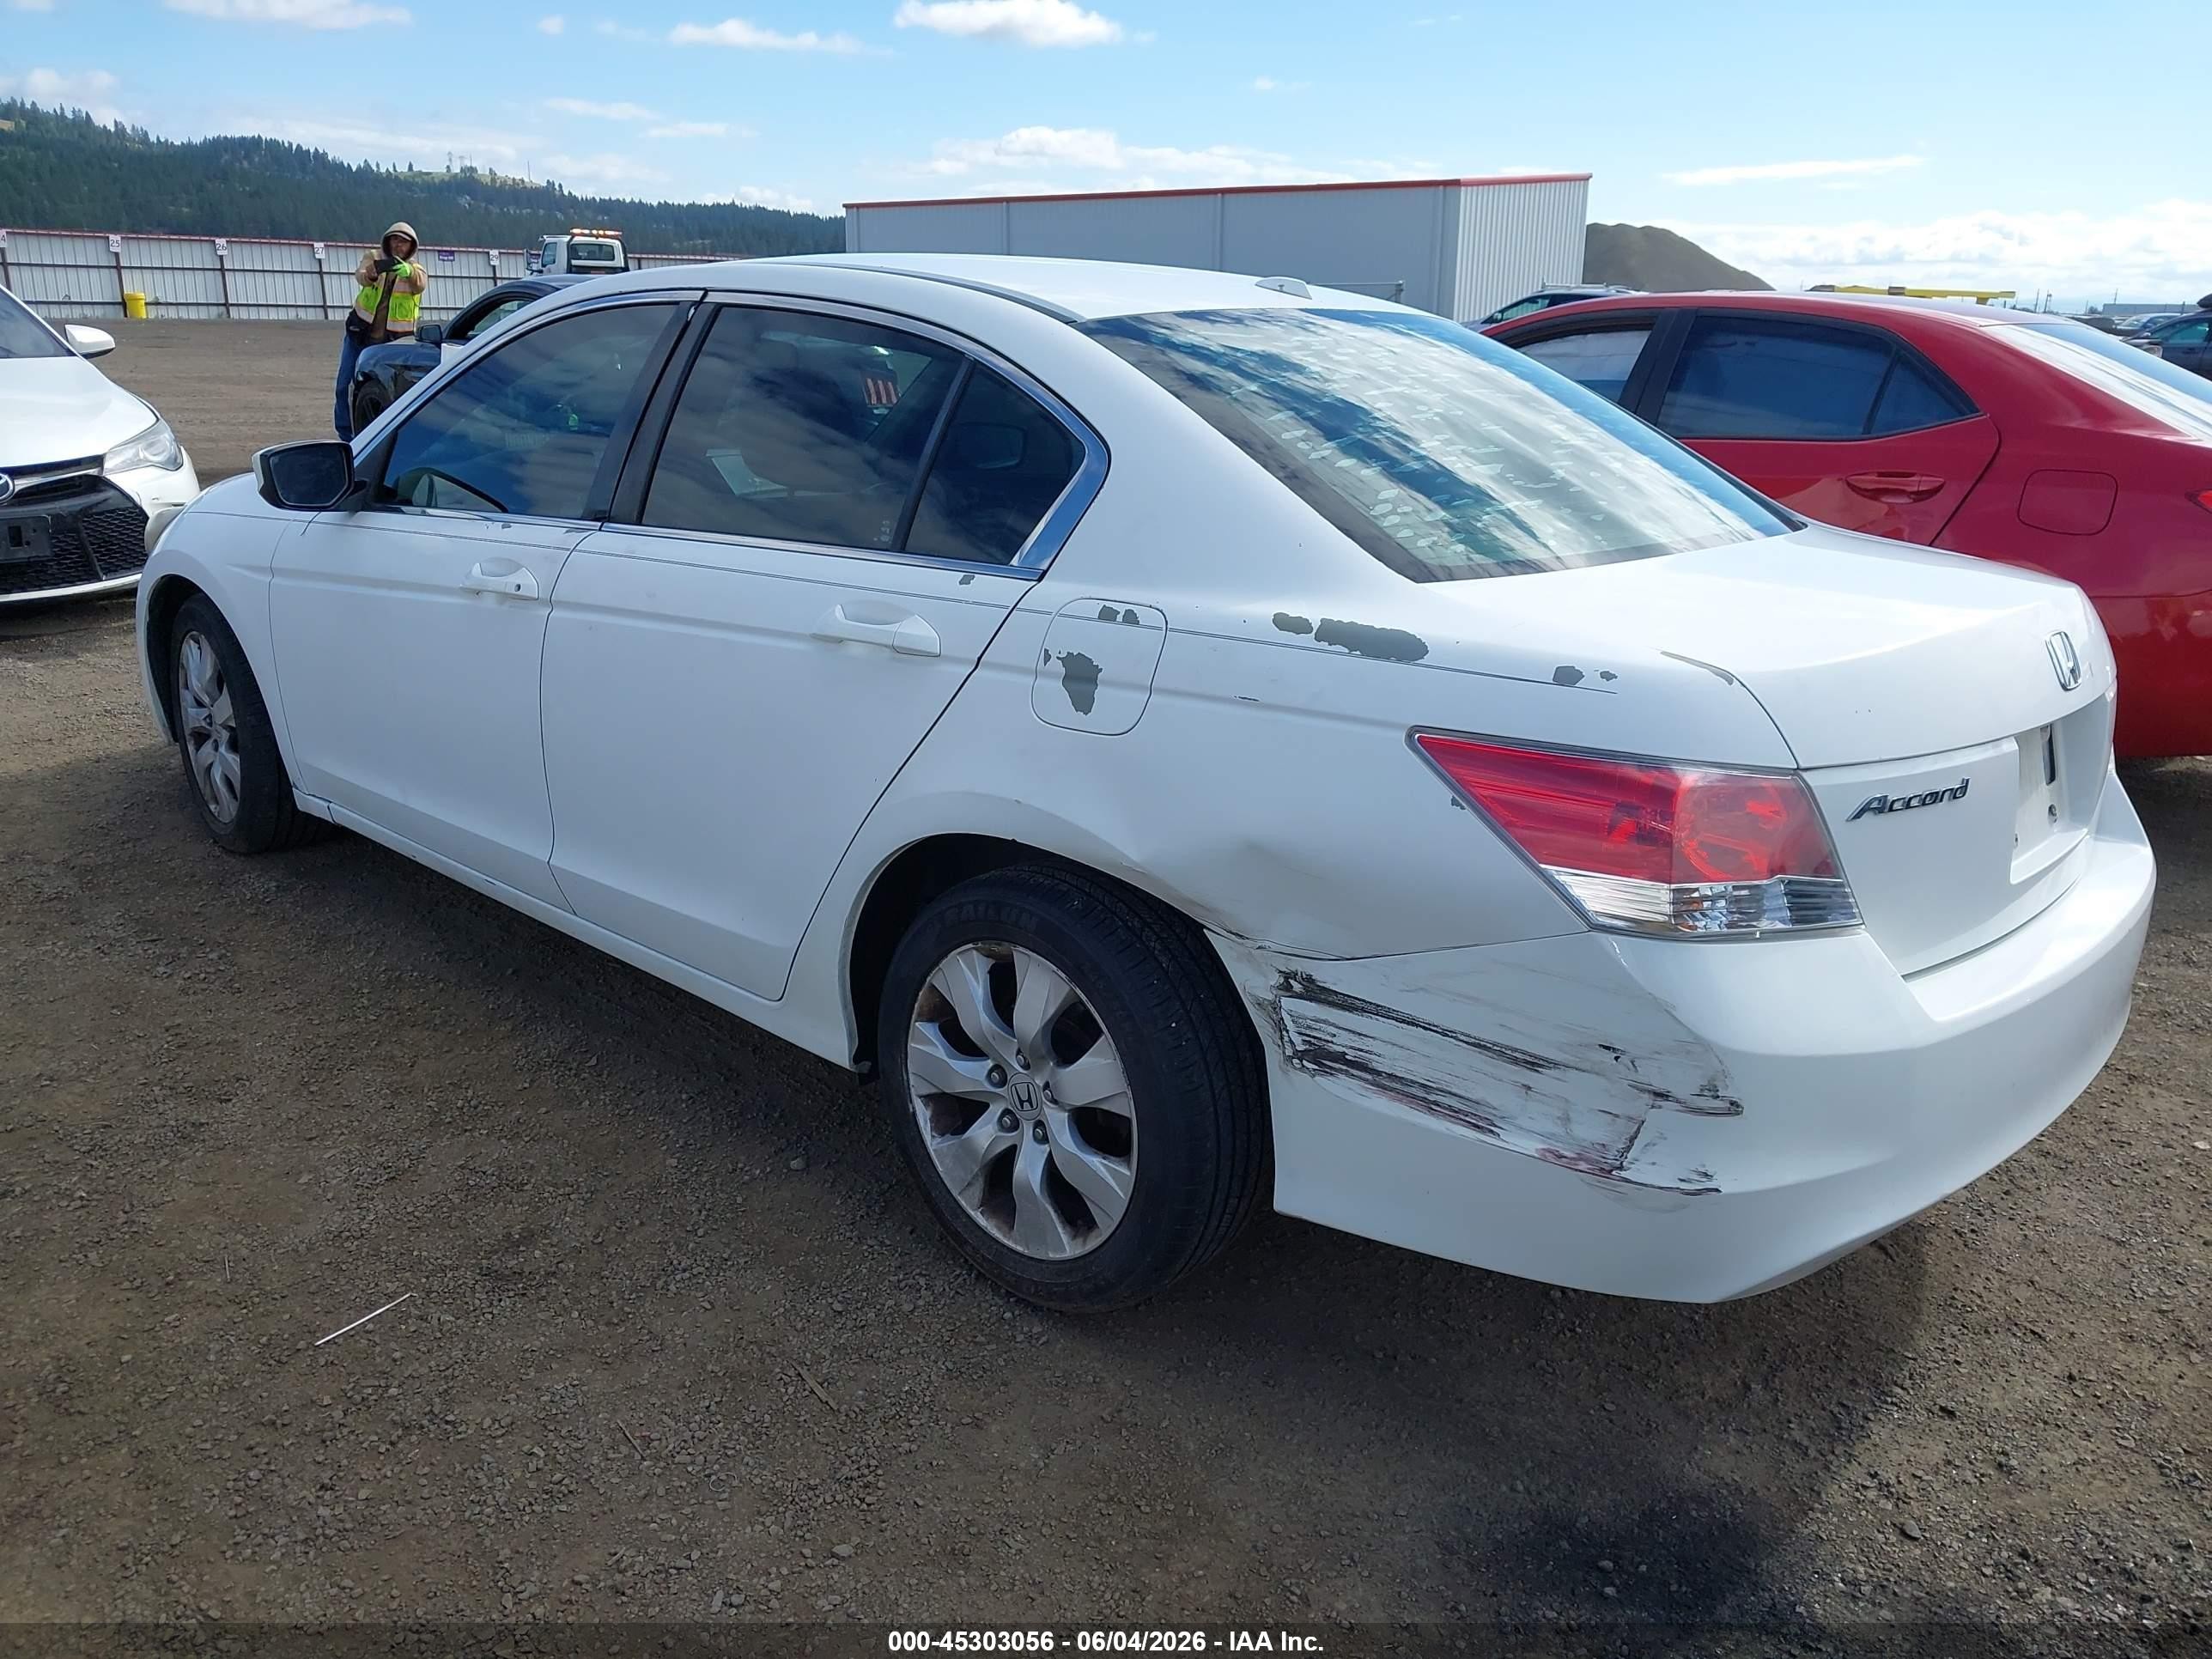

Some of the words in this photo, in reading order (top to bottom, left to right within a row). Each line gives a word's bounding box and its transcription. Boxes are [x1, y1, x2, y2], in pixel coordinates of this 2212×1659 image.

[110, 239, 120, 248] 25
[216, 242, 228, 251] 26
[314, 246, 325, 255] 27
[1845, 776, 1971, 823] Accord
